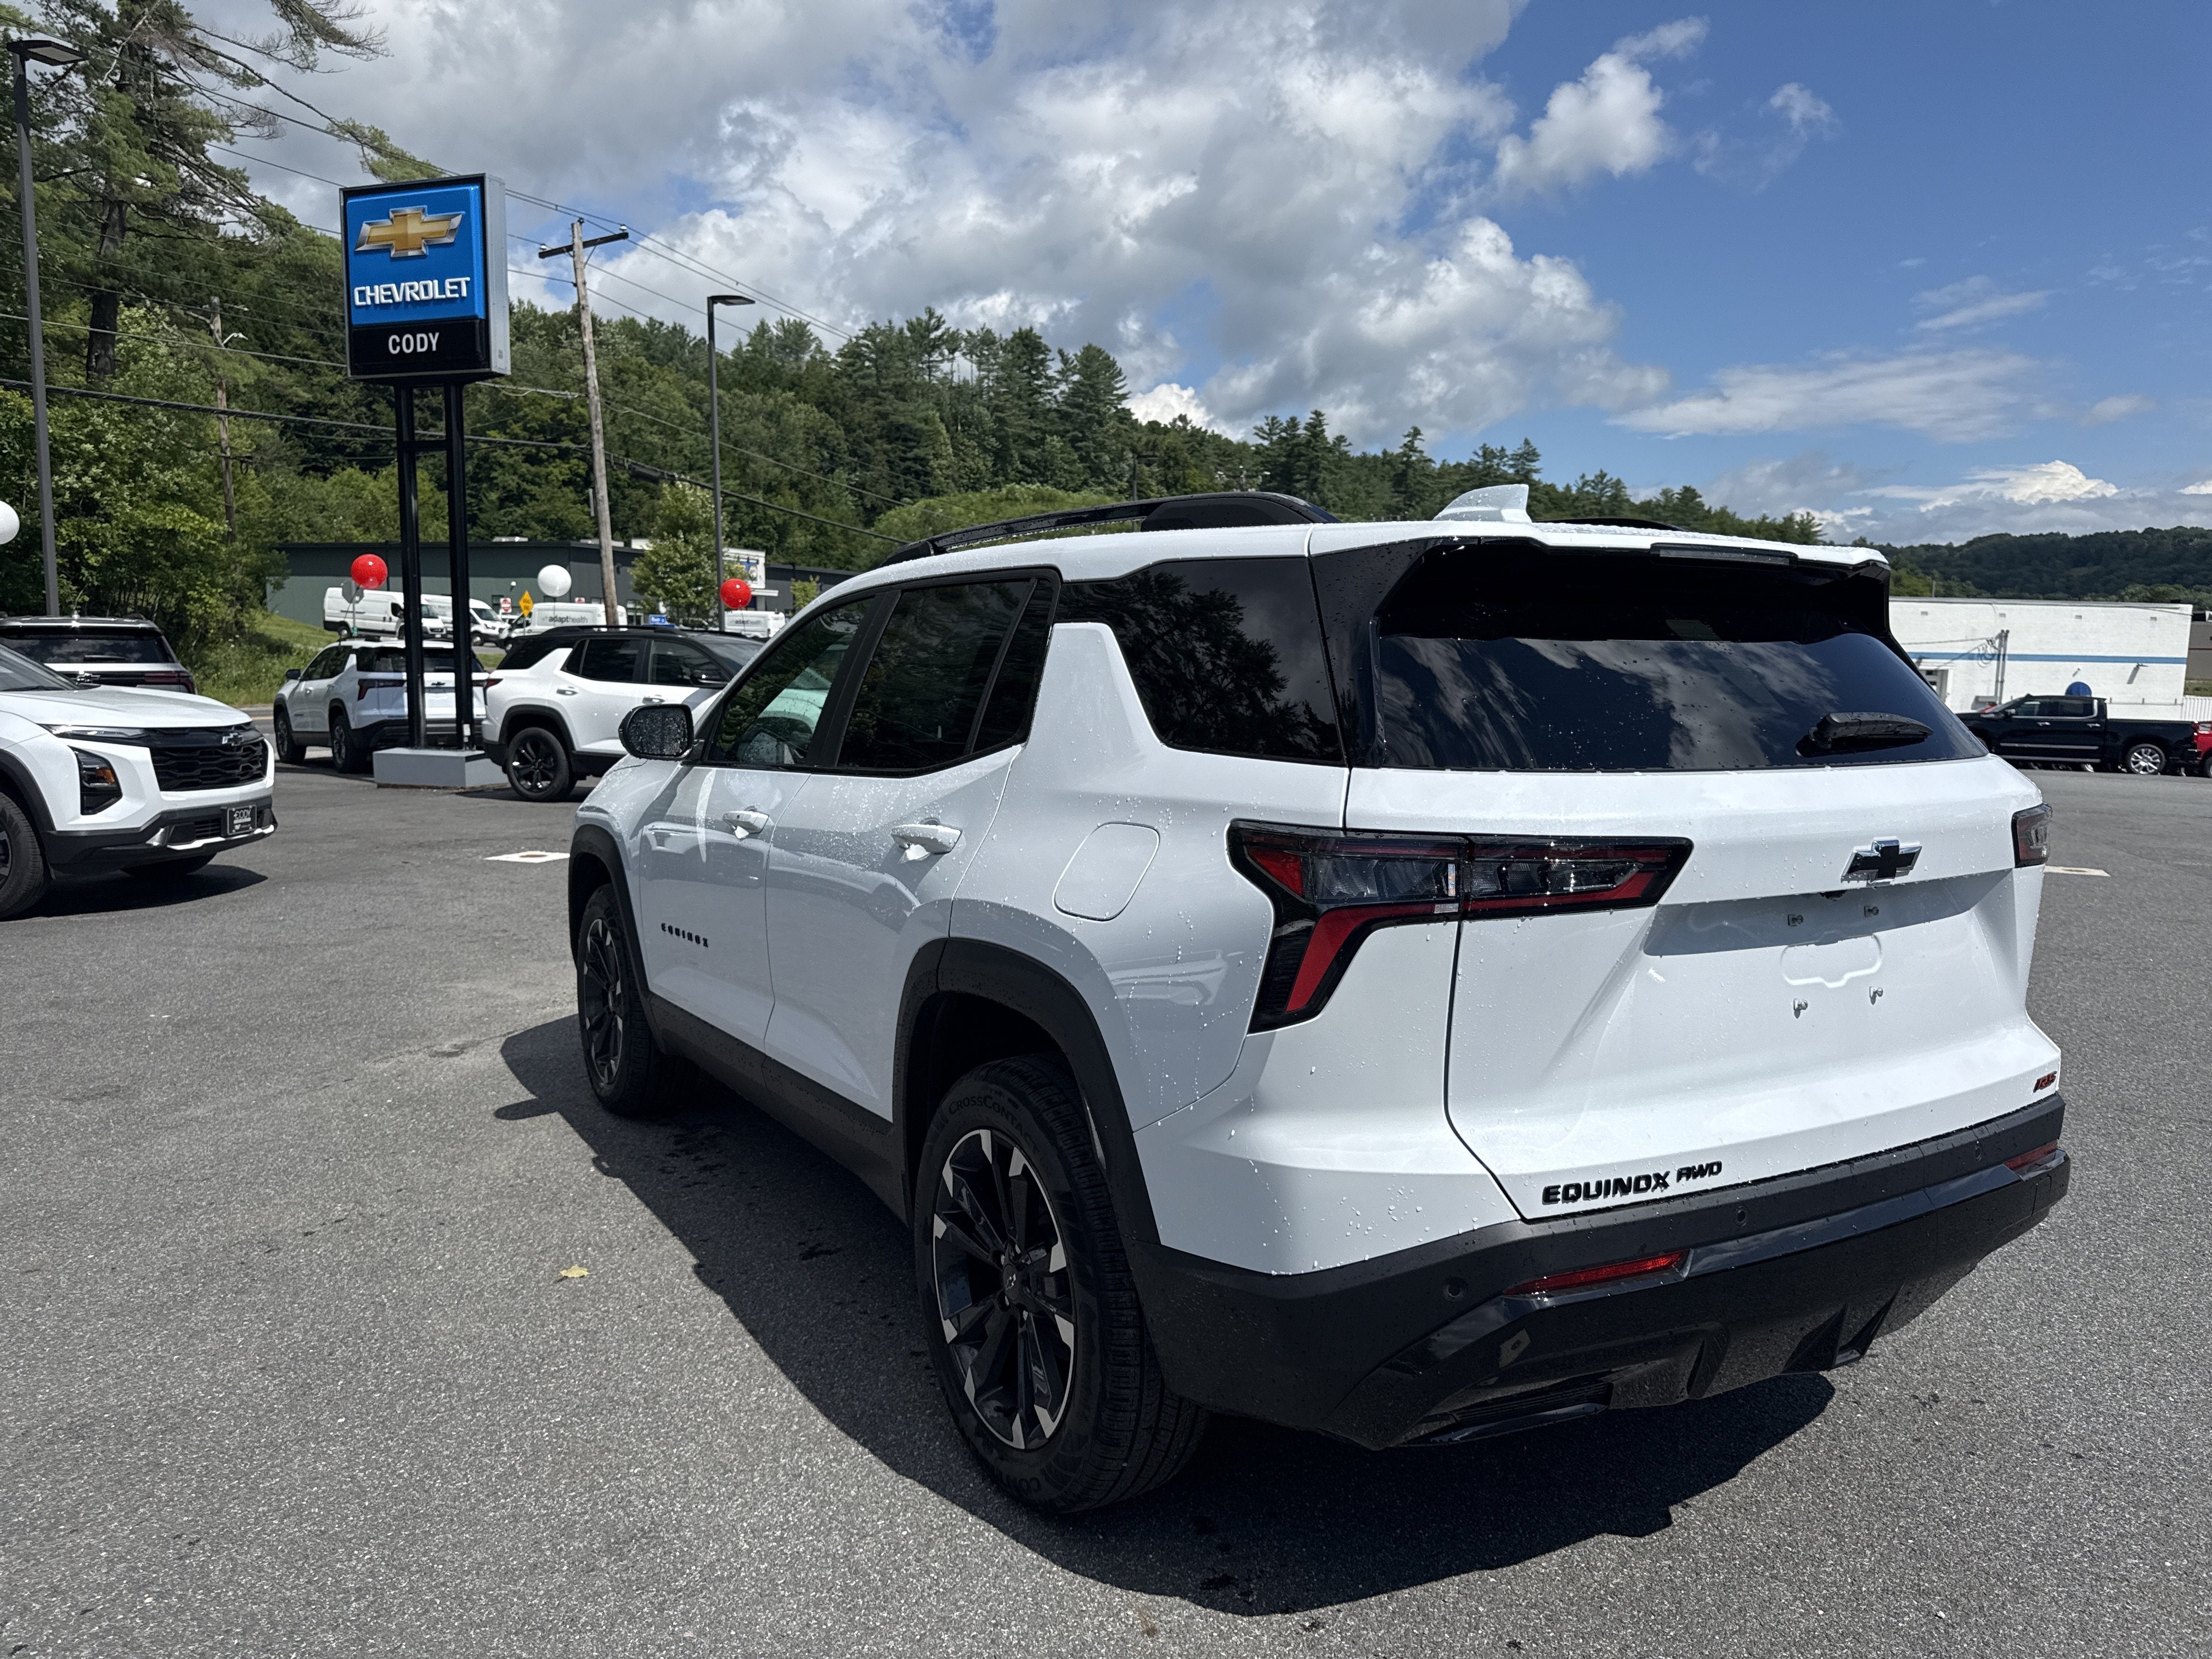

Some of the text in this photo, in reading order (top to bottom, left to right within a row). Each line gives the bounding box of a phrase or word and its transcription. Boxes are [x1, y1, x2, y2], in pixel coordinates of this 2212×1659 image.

[354, 276, 471, 306] CHEVROLET
[388, 332, 439, 354] CODY
[549, 615, 588, 624] adapthealth
[661, 923, 709, 948] EQUINOX
[2033, 1070, 2057, 1093] RS
[1542, 1160, 1723, 1205] EQUINOX AWD
